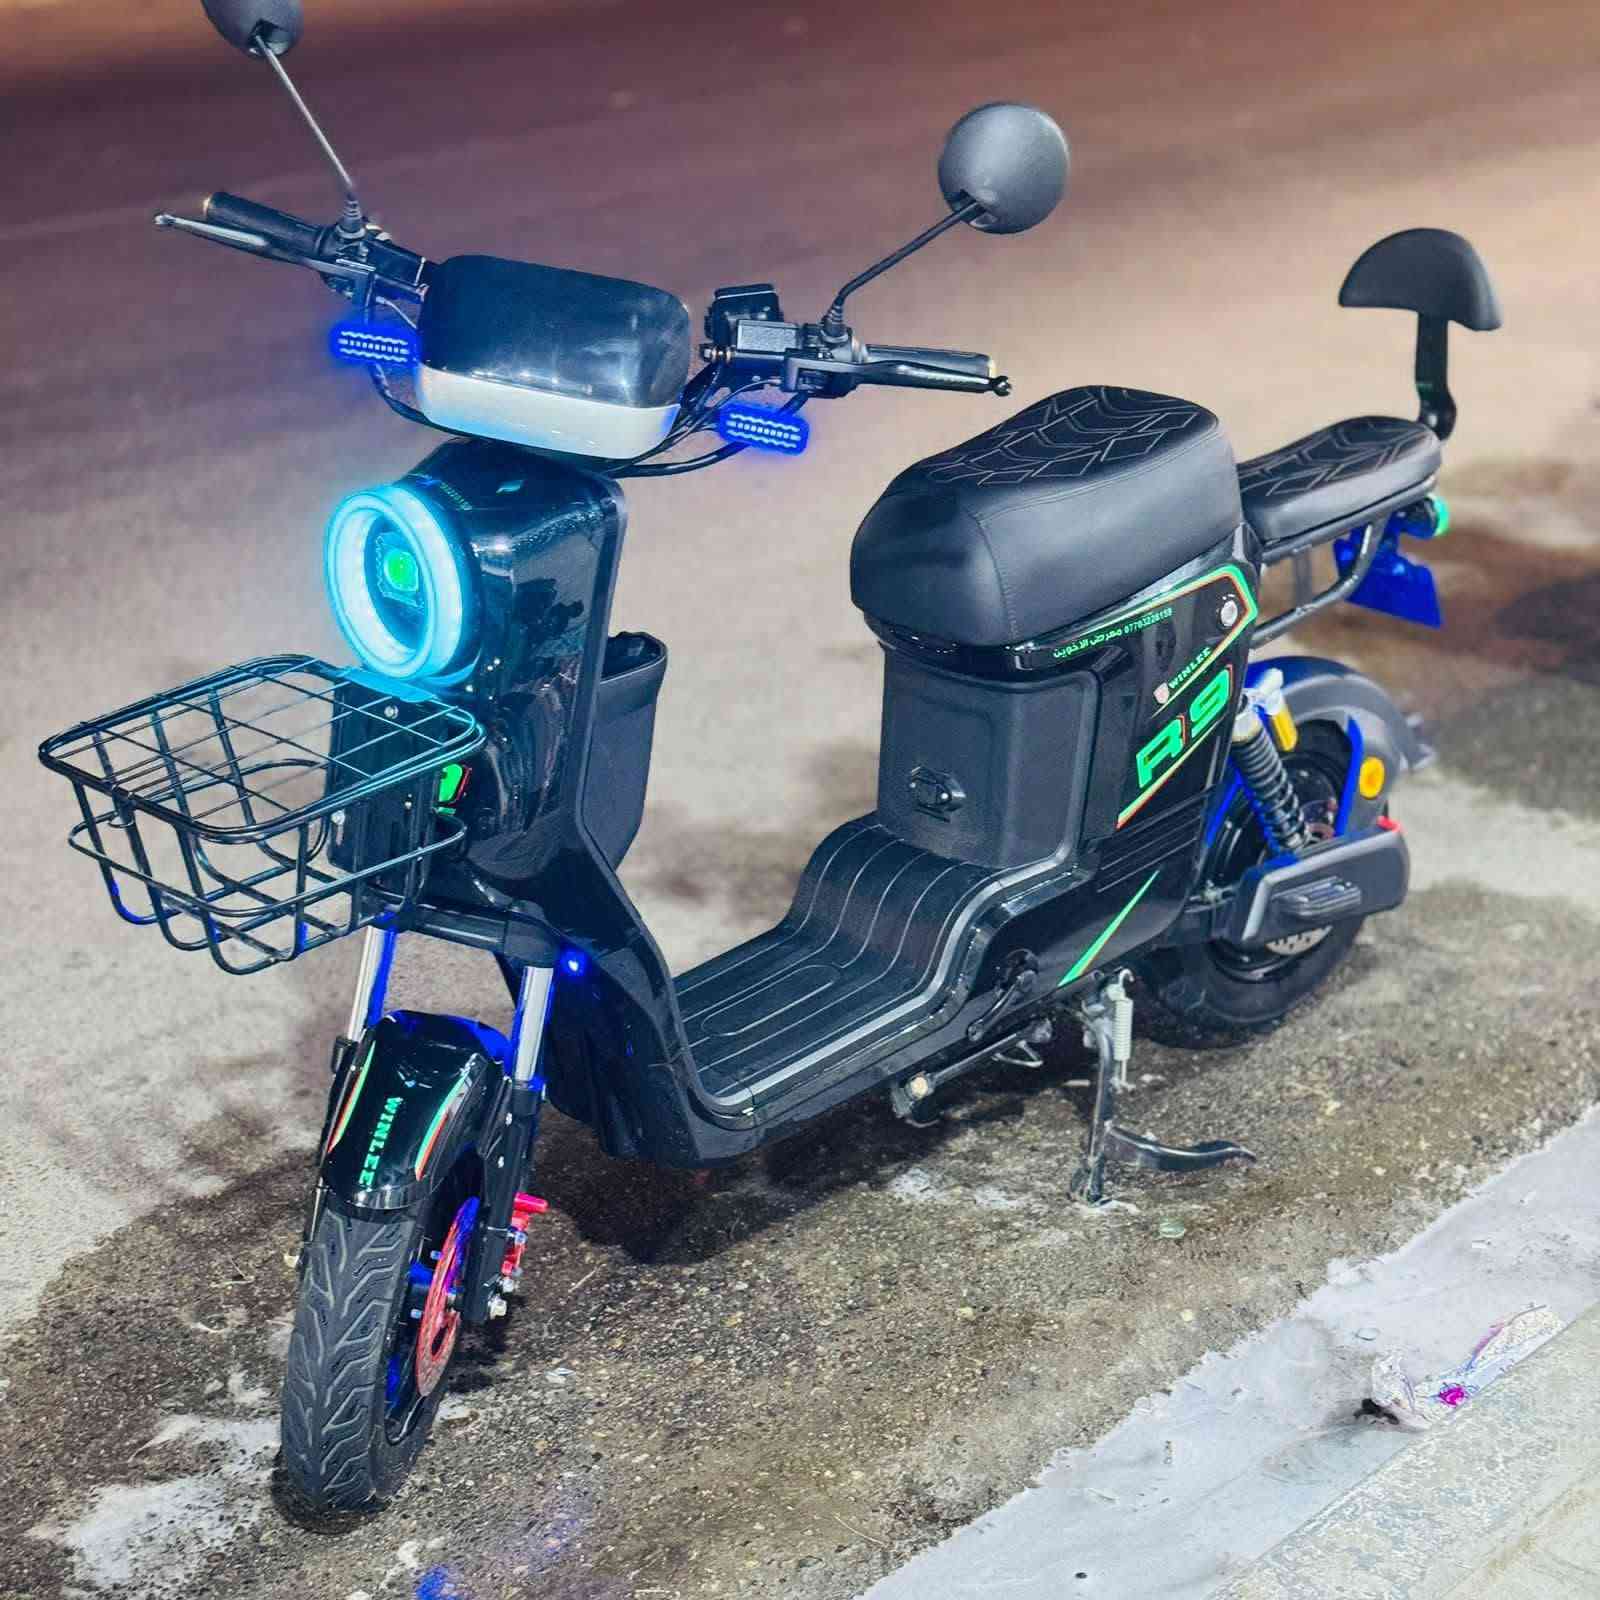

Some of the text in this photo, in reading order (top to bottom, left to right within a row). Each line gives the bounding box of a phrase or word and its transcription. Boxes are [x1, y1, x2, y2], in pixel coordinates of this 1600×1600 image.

[1168, 647, 1211, 689] WINLEE
[1136, 665, 1233, 788] R9
[359, 1097, 403, 1185] WINLEE
